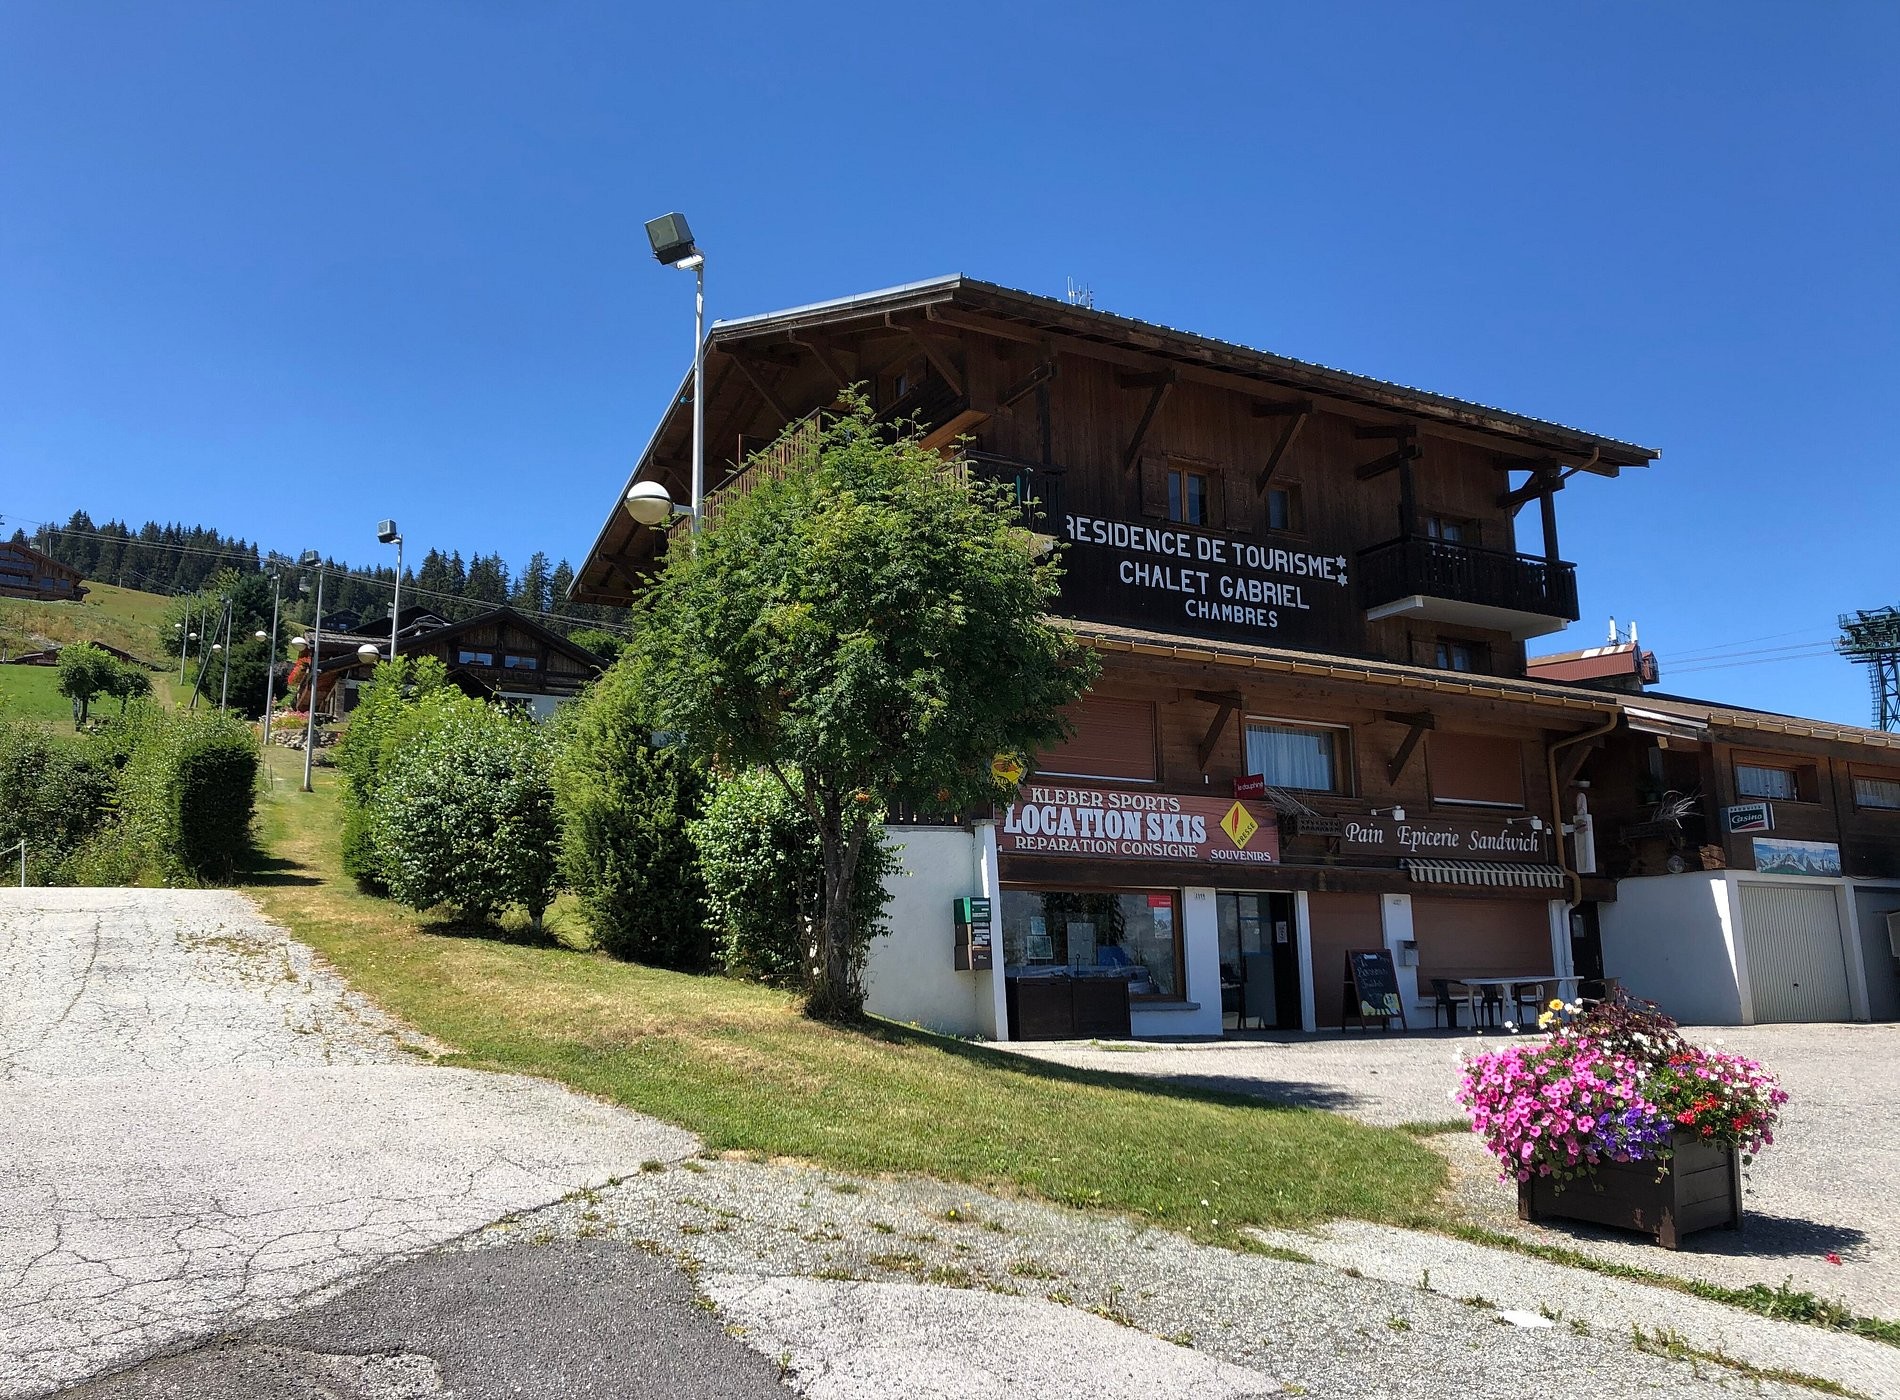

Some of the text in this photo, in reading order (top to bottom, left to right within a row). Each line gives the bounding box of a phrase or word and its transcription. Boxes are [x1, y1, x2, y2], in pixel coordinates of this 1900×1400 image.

[1066, 514, 1337, 580] RESIDENCE DE TOURISME
[1119, 560, 1310, 610] CHALET GABRIEL
[1185, 599, 1278, 628] CHAMBRES
[1031, 787, 1181, 813] KLEBER SPORTS
[1003, 803, 1207, 844] LOCATION SKIS
[1731, 814, 1762, 823] Casino
[1015, 835, 1199, 859] REPARATION CONSIGNE
[1236, 821, 1256, 846] PRESSE
[1345, 822, 1539, 852] Pain Epicerie Sandwich
[1210, 848, 1271, 862] SOUVENIRS
